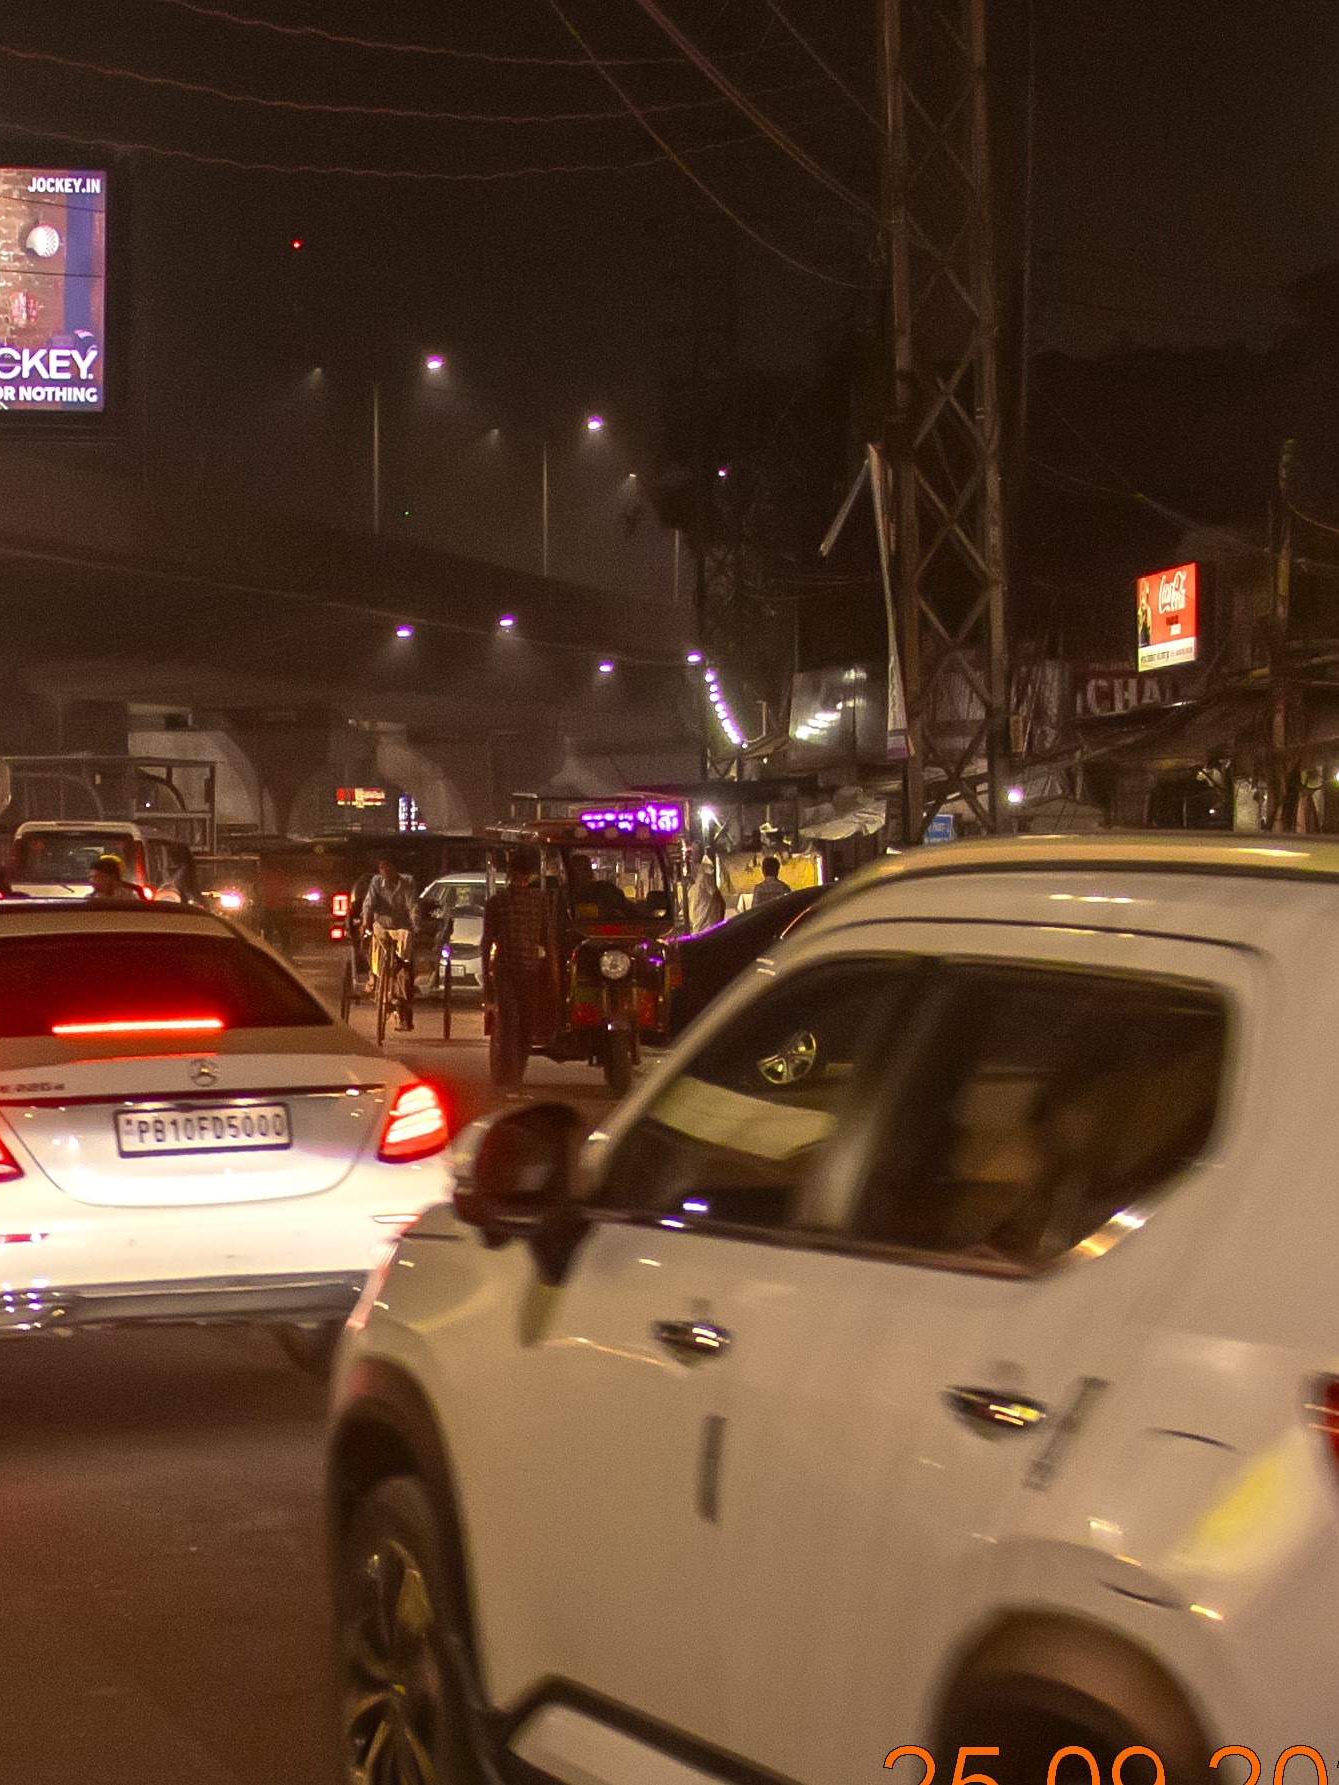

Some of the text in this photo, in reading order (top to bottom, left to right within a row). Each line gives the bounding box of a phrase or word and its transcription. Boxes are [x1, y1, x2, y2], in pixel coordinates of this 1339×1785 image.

[27, 177, 100, 194] JOCKEY.IN
[19, 386, 98, 403] NOTHING
[137, 1113, 283, 1144] PB10FD5000
